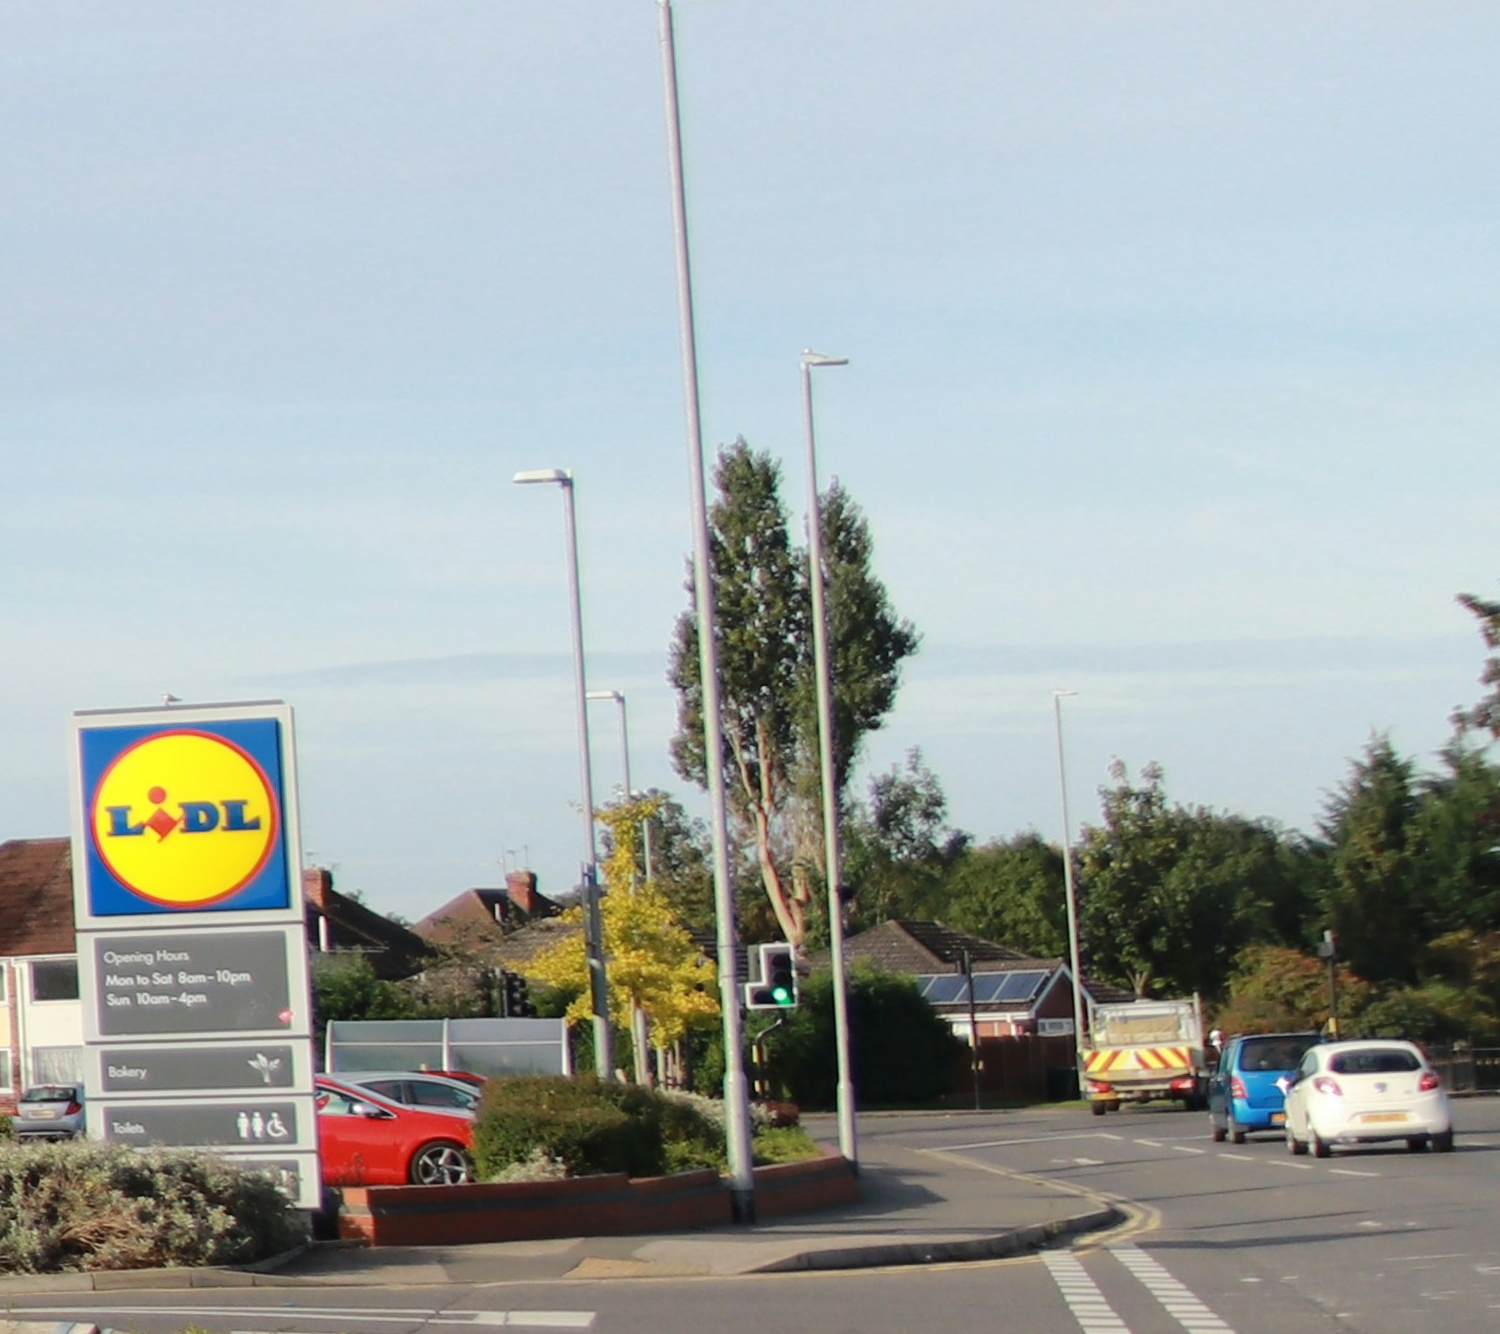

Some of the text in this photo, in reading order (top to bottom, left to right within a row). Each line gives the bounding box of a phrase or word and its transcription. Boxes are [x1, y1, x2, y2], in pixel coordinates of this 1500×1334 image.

[103, 950, 190, 966] Opening Hours
[105, 974, 134, 987] Mon
[136, 974, 149, 986] to
[152, 972, 173, 985] Sat
[106, 993, 131, 1006] Sun
[108, 1066, 147, 1080] Bakery
[111, 1121, 145, 1134] Toilets
